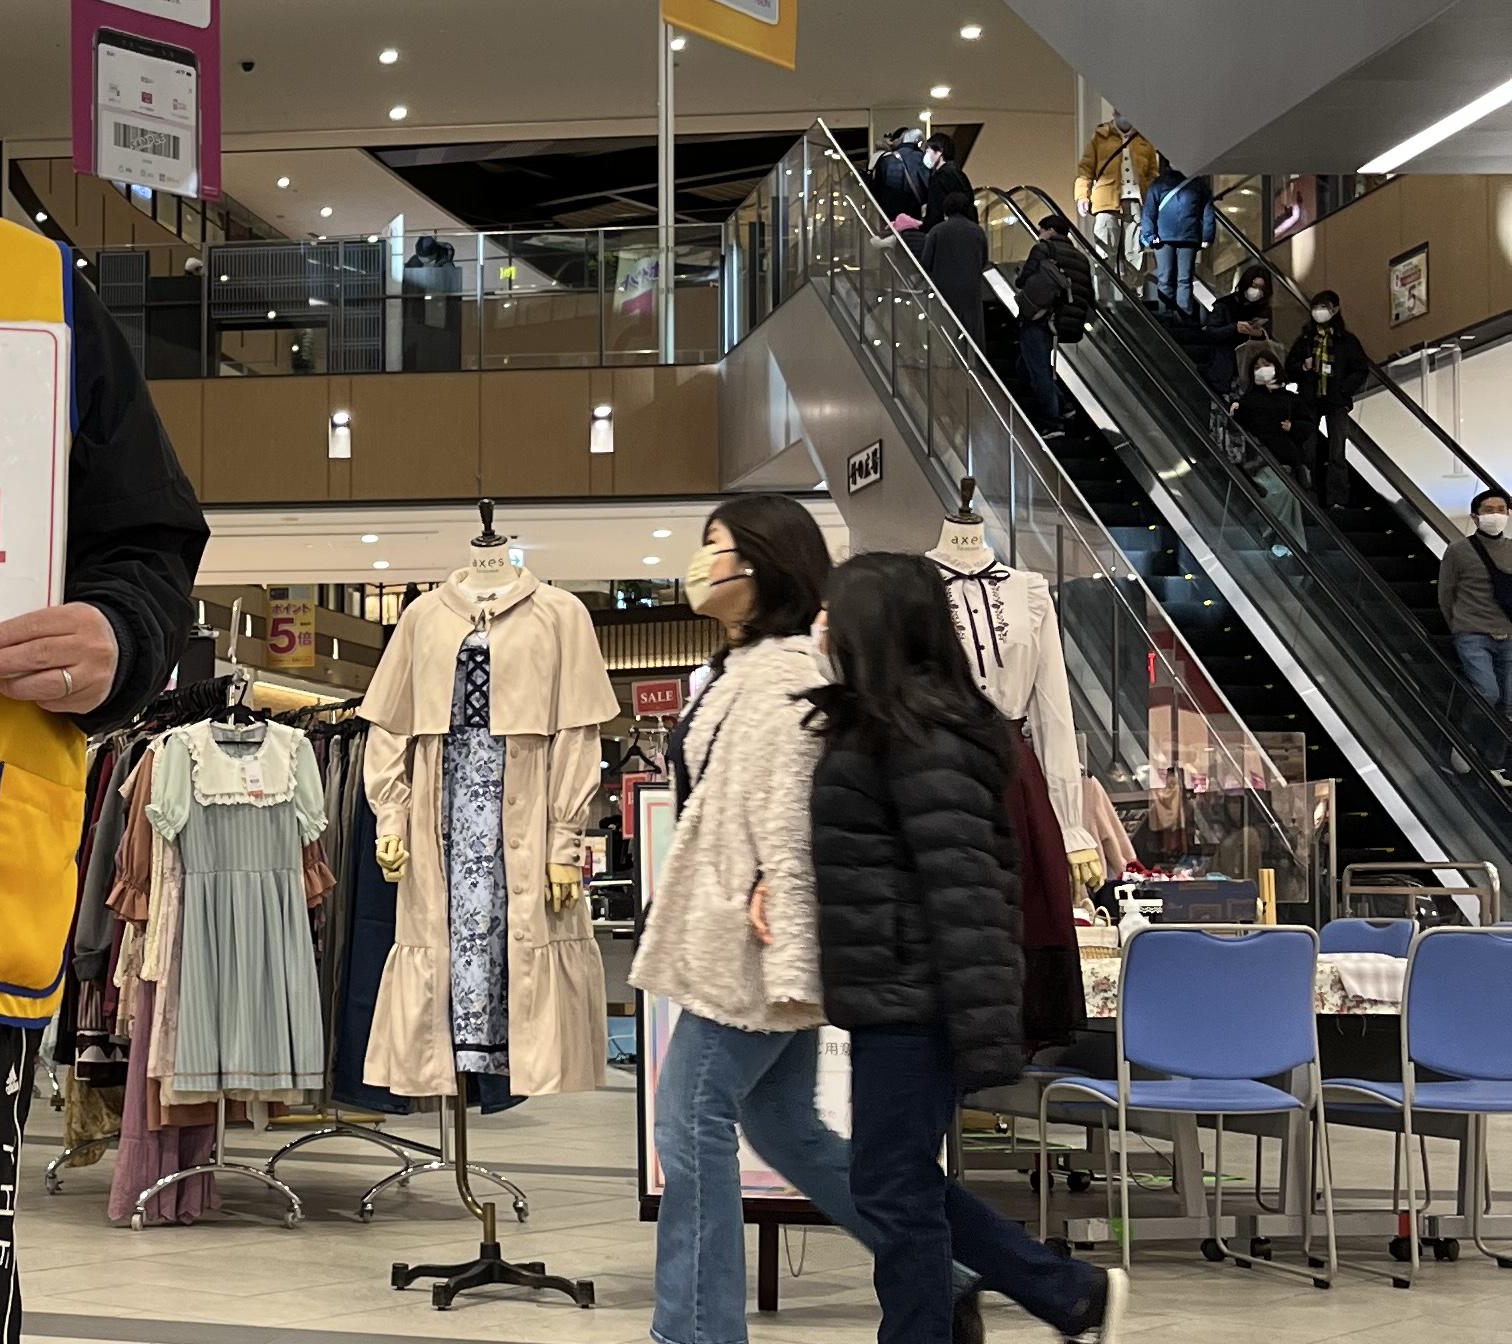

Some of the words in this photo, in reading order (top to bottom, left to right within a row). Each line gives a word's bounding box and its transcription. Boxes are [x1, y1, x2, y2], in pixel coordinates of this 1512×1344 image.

[472, 558, 504, 568] axes
[269, 617, 296, 654] 5
[640, 690, 674, 704] SALE
